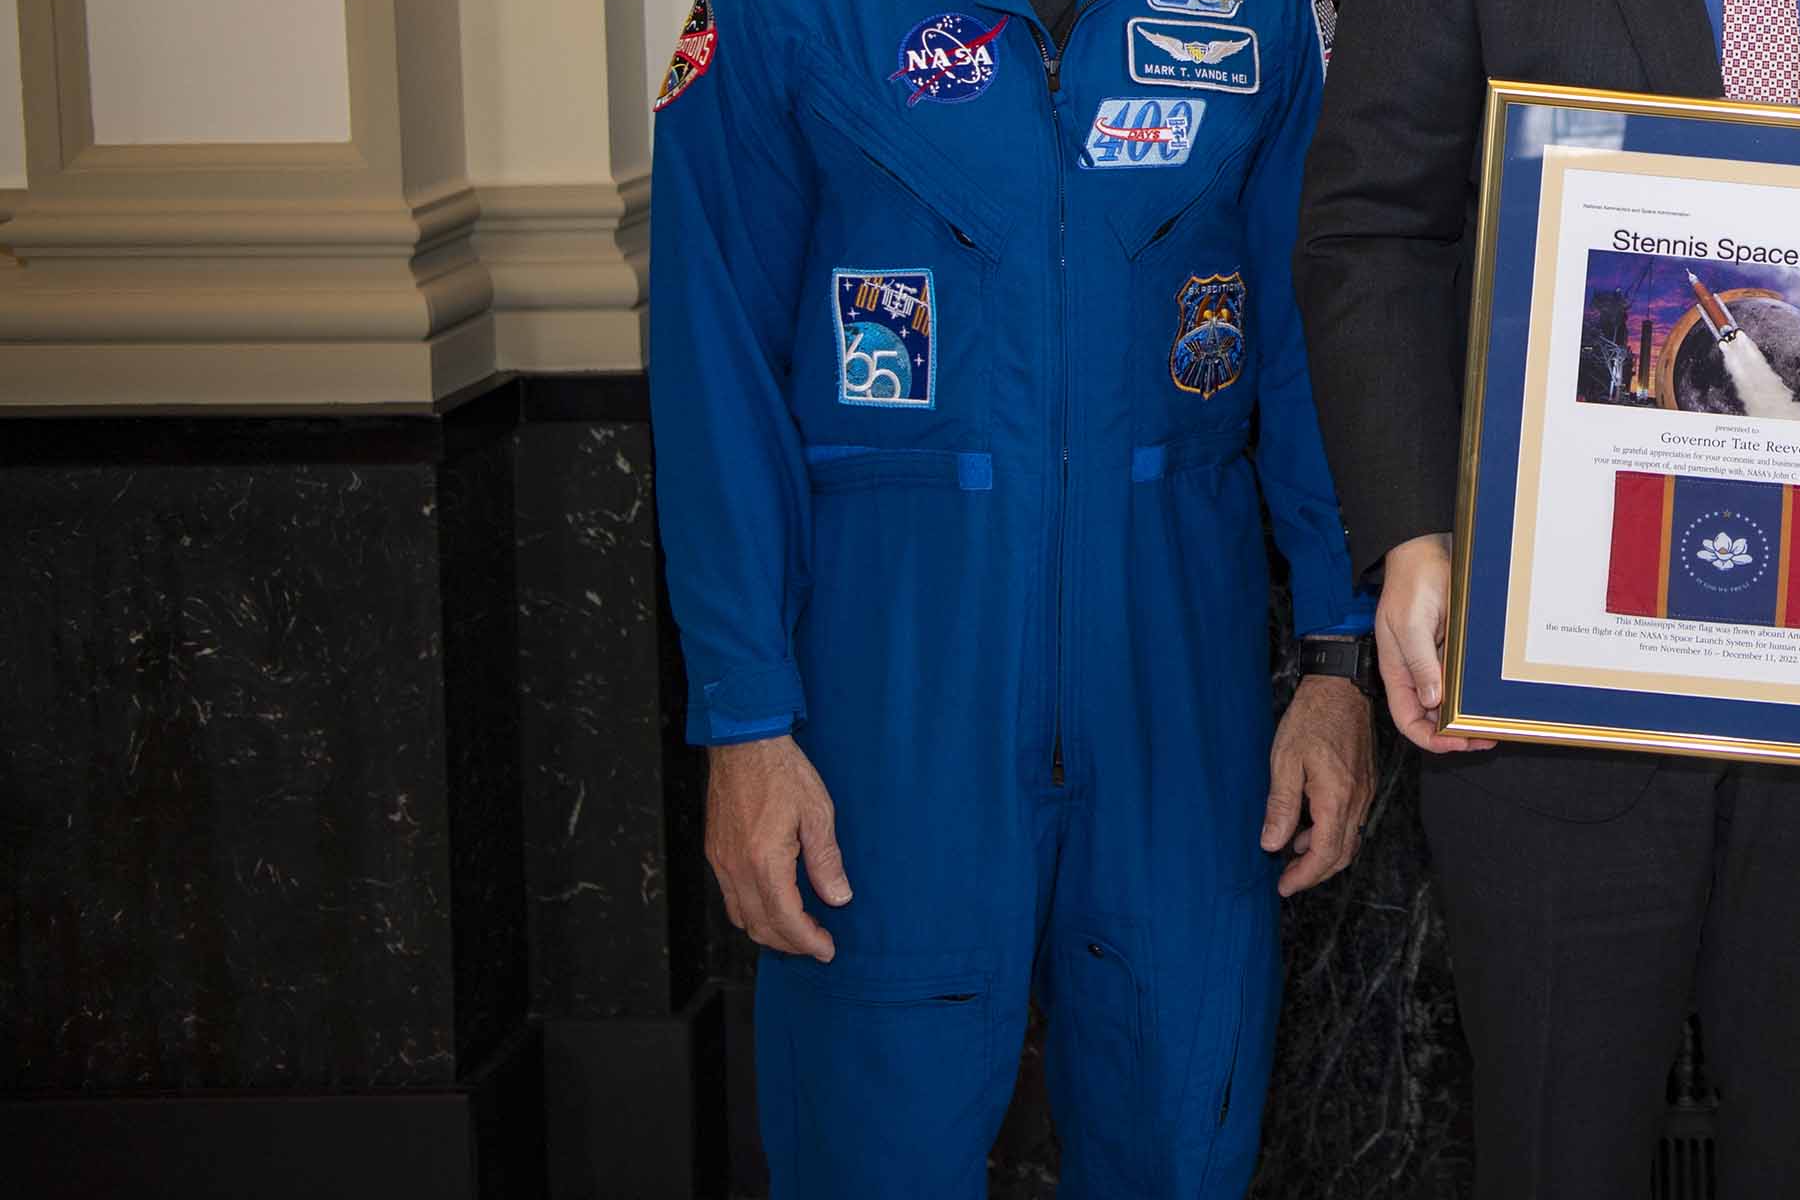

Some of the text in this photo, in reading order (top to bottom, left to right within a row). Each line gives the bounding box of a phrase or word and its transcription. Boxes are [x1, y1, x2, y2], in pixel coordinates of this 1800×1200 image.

[906, 45, 993, 71] NASA
[1144, 63, 1248, 84] MARK T. VANDE HEI
[1094, 101, 1192, 161] 400
[1128, 130, 1160, 140] DAYS
[1612, 229, 1709, 257] Stennis
[1716, 239, 1799, 265] Space
[846, 332, 901, 399] 65
[1715, 425, 1750, 434] presented
[1660, 432, 1727, 448] Governor
[1732, 437, 1760, 451] Tate
[1622, 447, 1647, 456] grateful
[1649, 449, 1691, 459] appreciation
[1693, 452, 1702, 460] for
[1757, 458, 1770, 466] and
[1593, 457, 1610, 465] your
[1673, 462, 1686, 470] and
[1688, 464, 1727, 475] partnership
[1772, 471, 1789, 480] John
[1546, 623, 1558, 631] the
[1561, 625, 1589, 634] maiden
[1592, 628, 1612, 637] flight
[1625, 630, 1637, 638] the
[1639, 631, 1668, 641] NASA's
[1670, 634, 1693, 643] Space
[1695, 636, 1724, 645] Launch
[1726, 638, 1753, 649] System
[1755, 640, 1767, 648] for
[1769, 642, 1796, 651] human
[1615, 617, 1632, 625] This
[1634, 619, 1675, 630] Mississippi
[1677, 623, 1696, 631] State
[1698, 624, 1713, 634] flag
[1732, 627, 1756, 636] flown
[1757, 630, 1785, 639] aboard
[1639, 643, 1658, 652] from
[1660, 645, 1700, 655] November
[1703, 649, 1713, 657] 16
[1722, 651, 1762, 661] December
